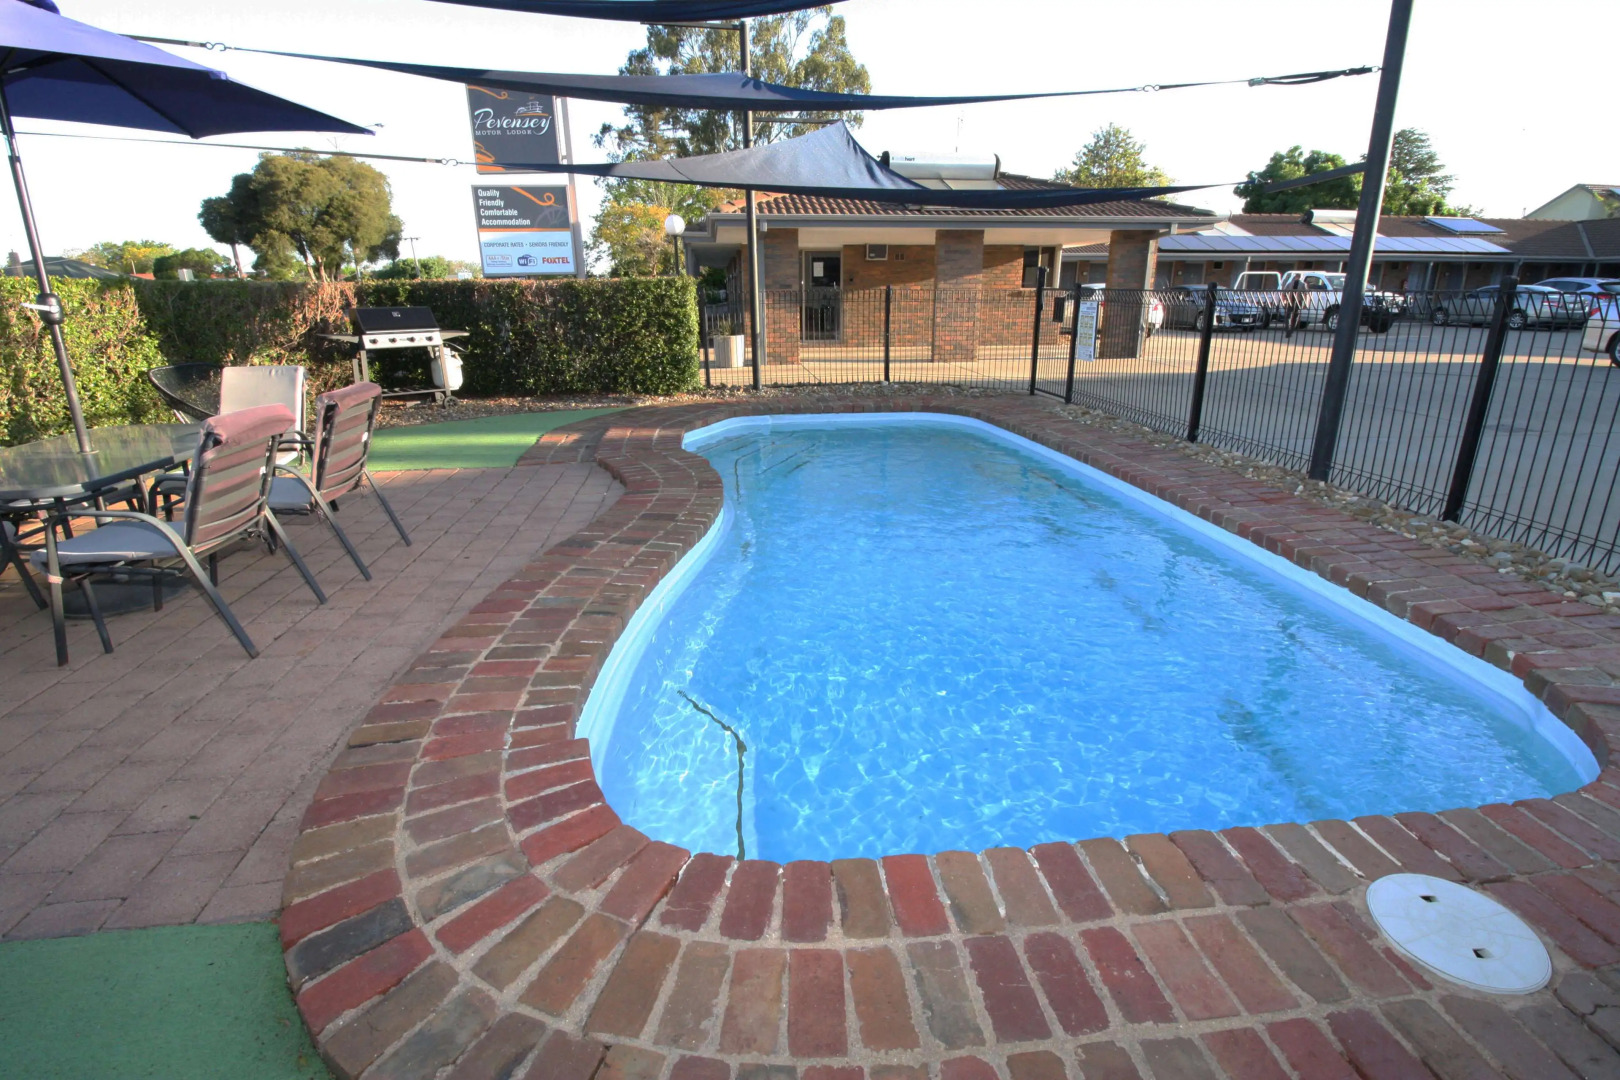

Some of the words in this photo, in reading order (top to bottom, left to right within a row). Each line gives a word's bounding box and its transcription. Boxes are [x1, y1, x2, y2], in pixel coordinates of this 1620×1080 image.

[474, 108, 552, 136] Pevensey
[477, 189, 500, 198] Quality
[479, 199, 505, 208] Friendly
[480, 208, 518, 216] Comfortable
[481, 218, 531, 226] Accommodation
